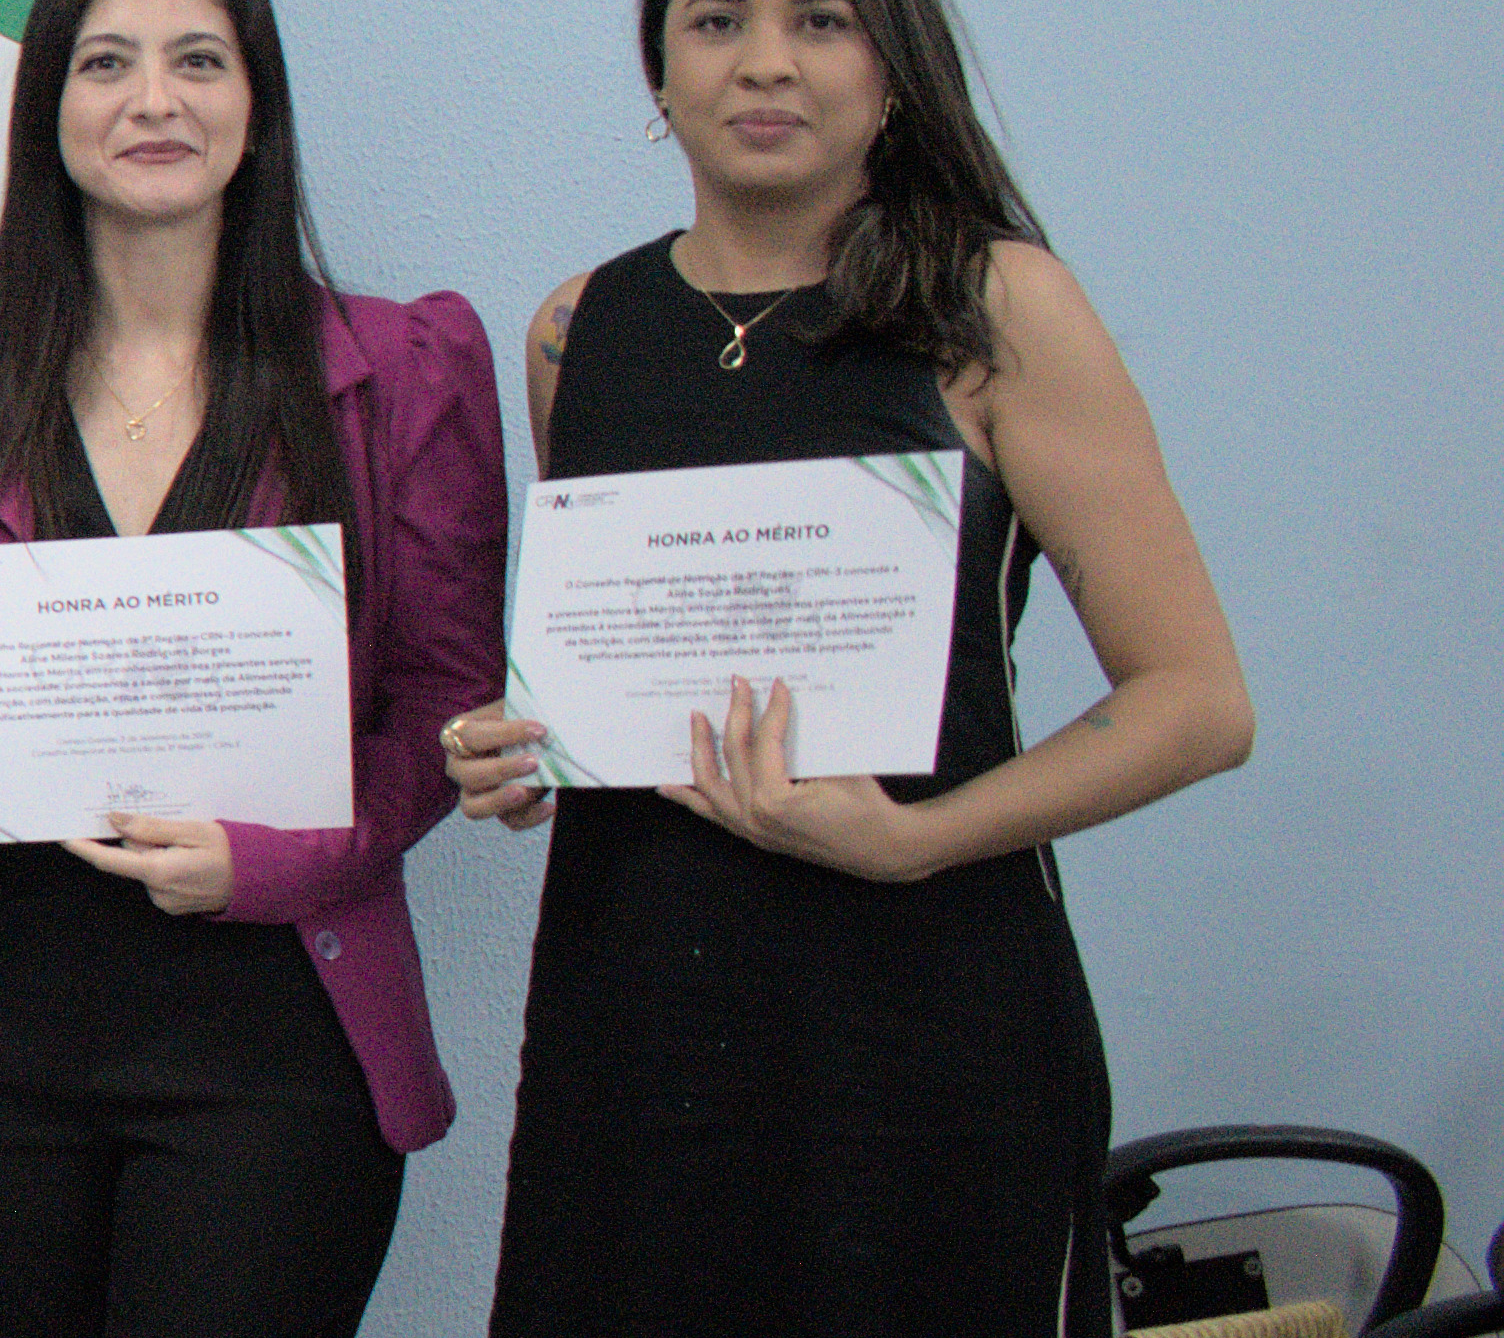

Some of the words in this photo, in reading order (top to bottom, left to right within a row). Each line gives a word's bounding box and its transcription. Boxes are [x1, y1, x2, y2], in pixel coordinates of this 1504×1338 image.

[647, 530, 715, 547] HONRA
[722, 528, 750, 543] AO
[756, 521, 829, 541] MÉRITO
[37, 597, 105, 613] HONRA
[112, 595, 140, 609] AO
[146, 588, 219, 607] MÉRITO
